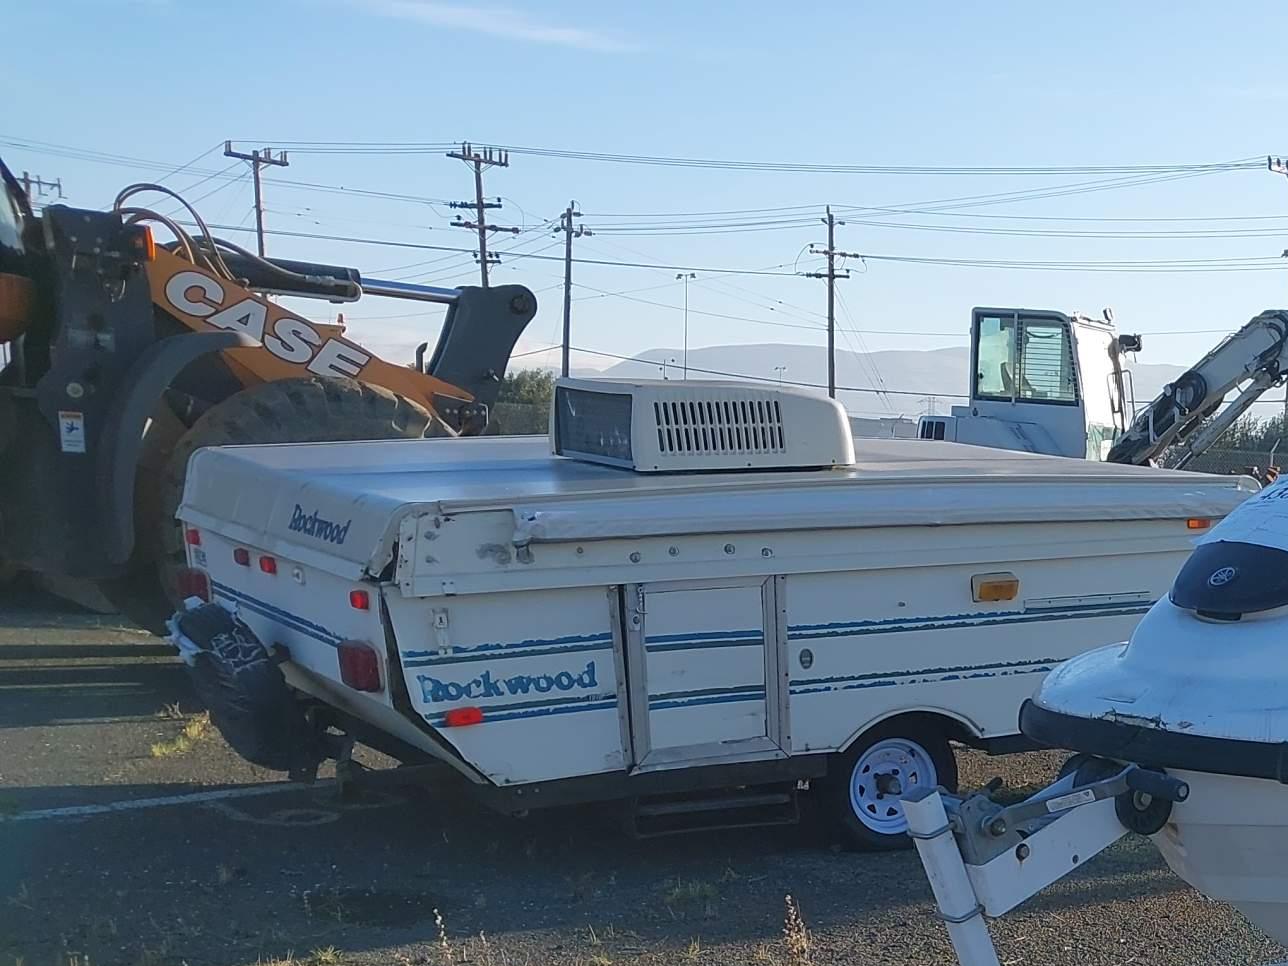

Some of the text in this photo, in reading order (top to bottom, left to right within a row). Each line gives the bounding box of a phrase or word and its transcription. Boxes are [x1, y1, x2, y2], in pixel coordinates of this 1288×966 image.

[165, 271, 372, 377] CASE
[287, 503, 352, 544] Rockwood
[417, 661, 599, 703] Rockwood
